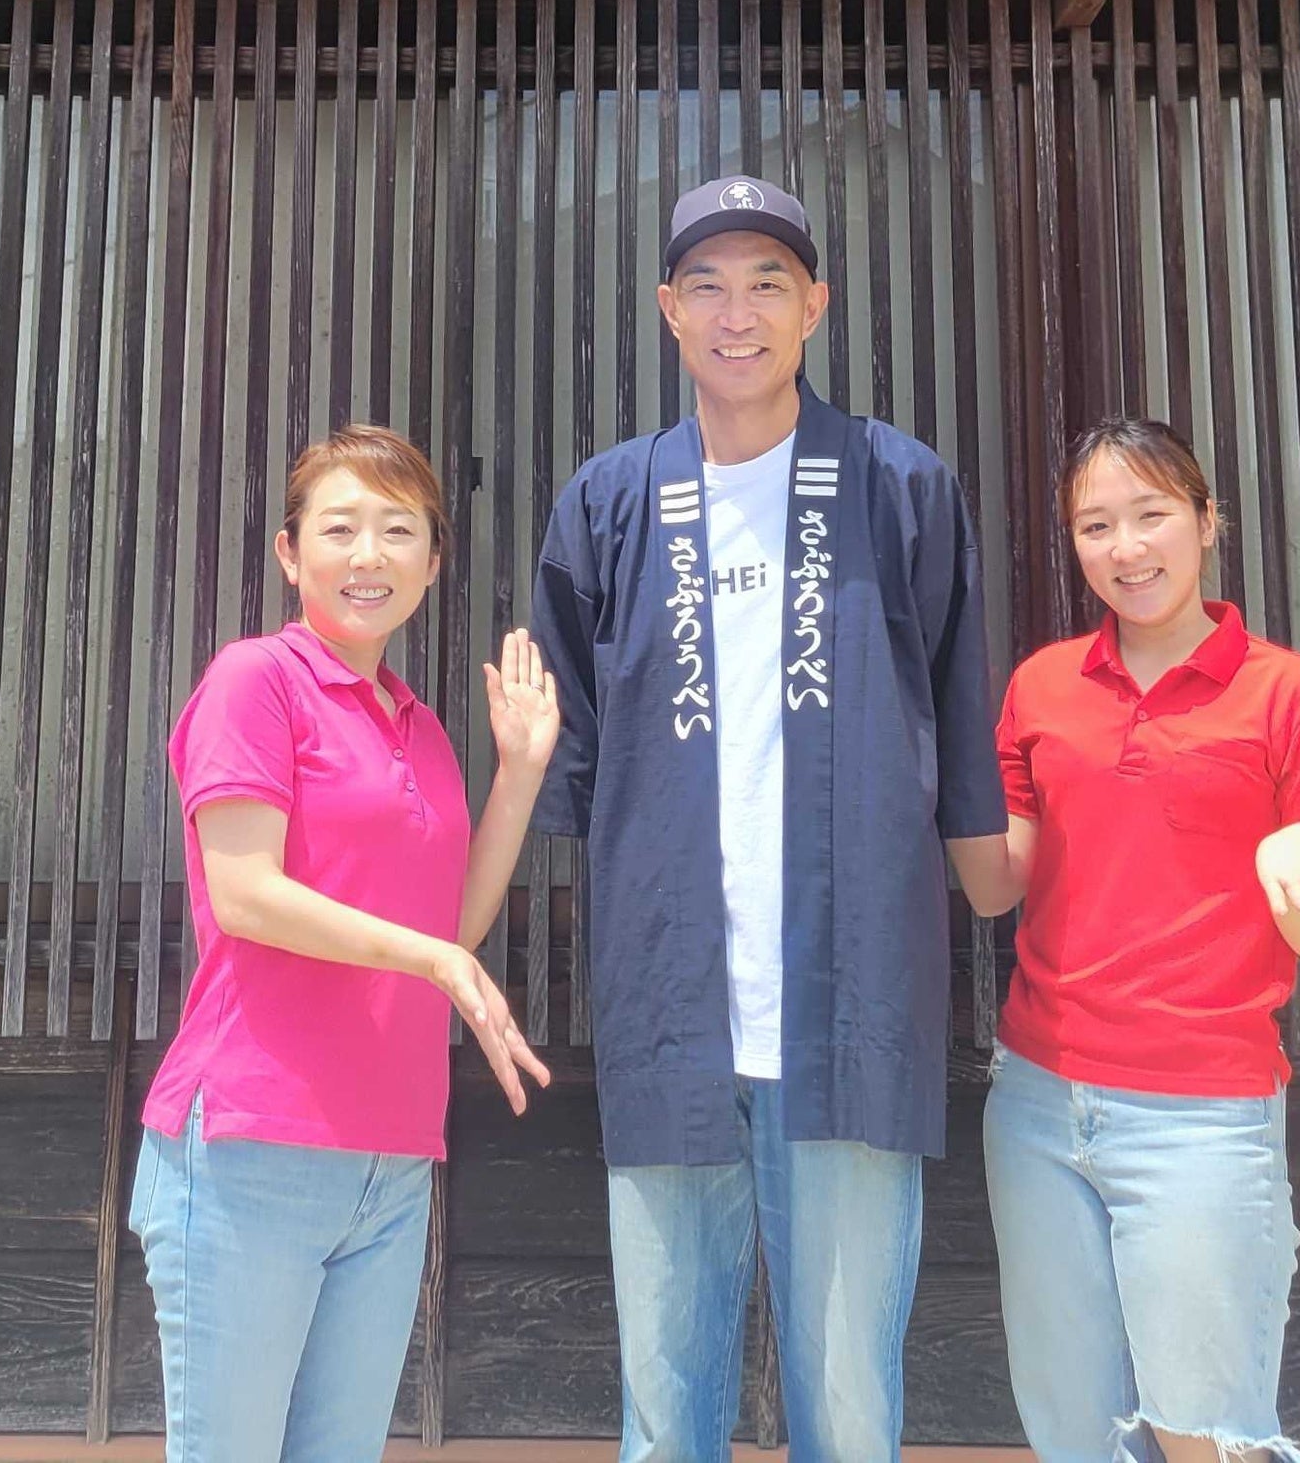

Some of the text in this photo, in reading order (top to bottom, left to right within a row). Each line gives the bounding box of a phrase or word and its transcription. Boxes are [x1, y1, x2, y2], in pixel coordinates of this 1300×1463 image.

[666, 536, 712, 740] さぶろうべい
[786, 509, 832, 711] さぶろうべい
